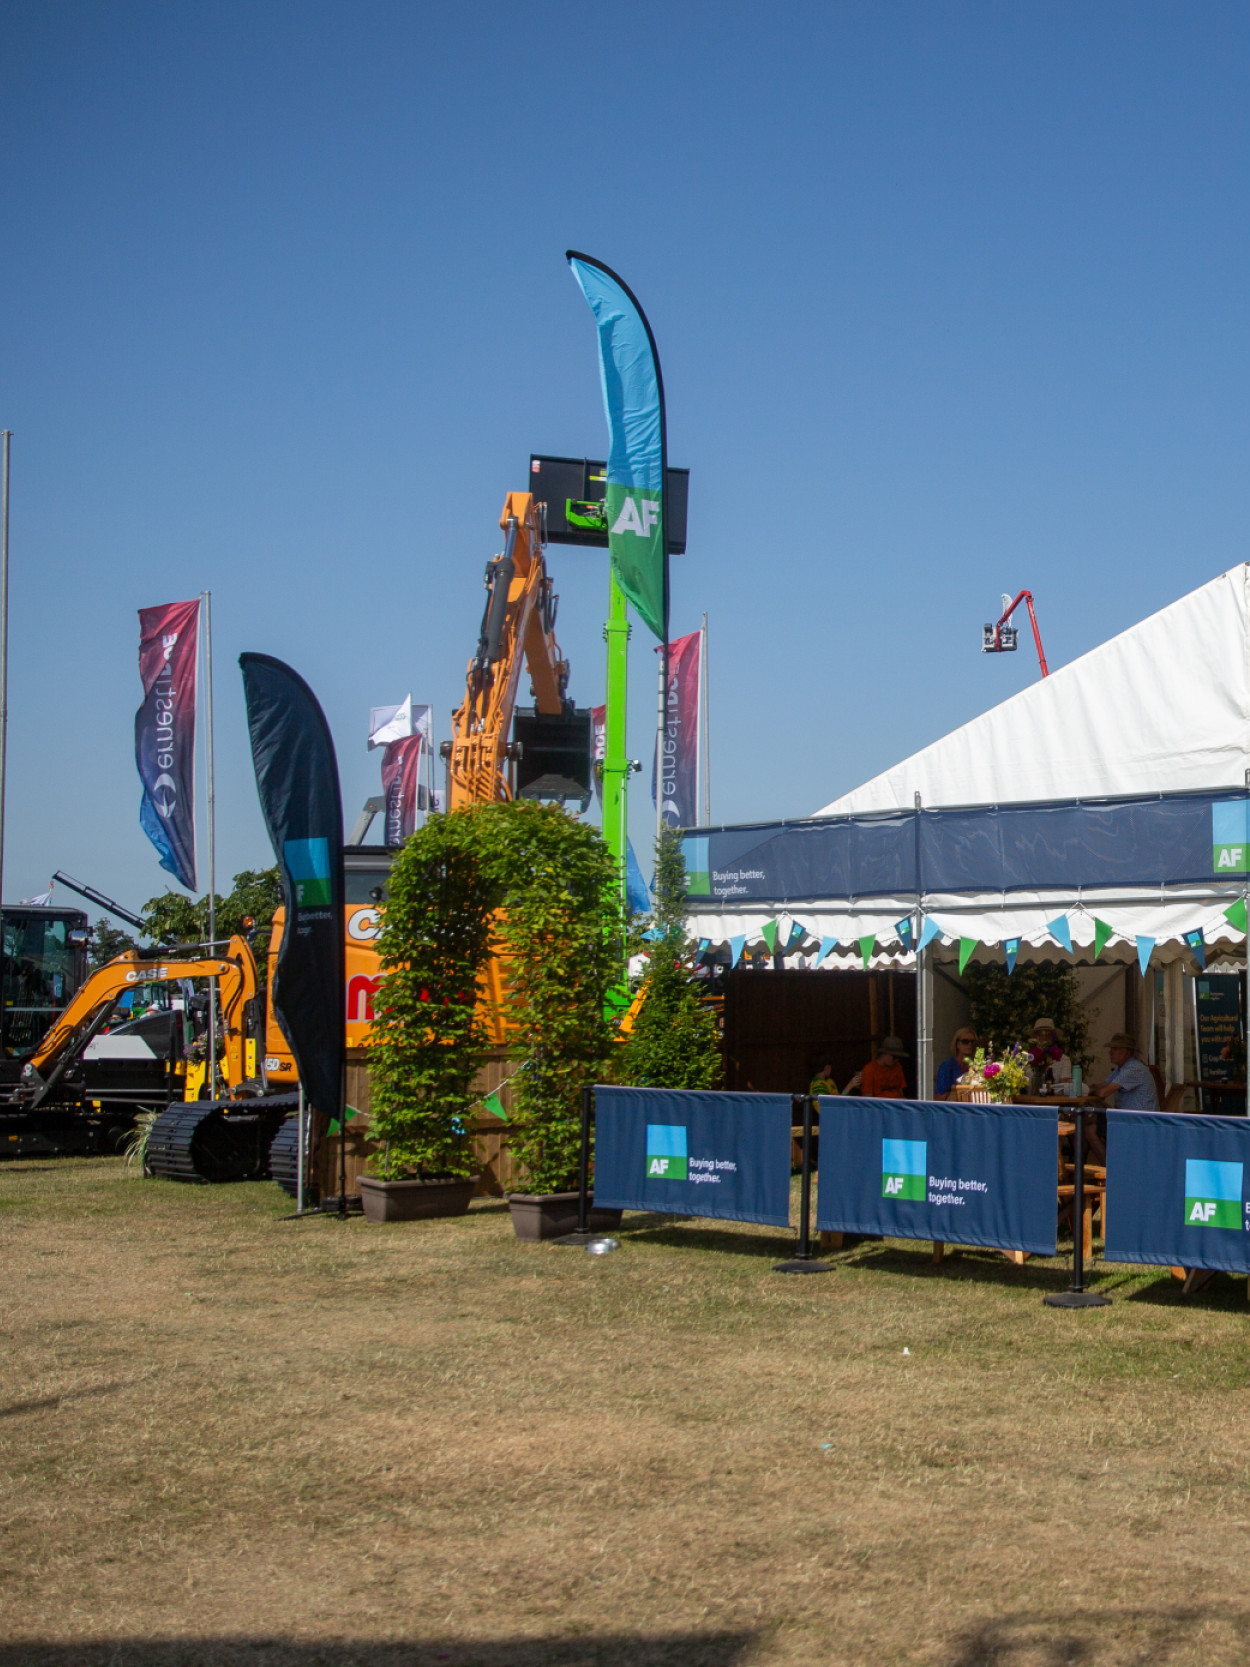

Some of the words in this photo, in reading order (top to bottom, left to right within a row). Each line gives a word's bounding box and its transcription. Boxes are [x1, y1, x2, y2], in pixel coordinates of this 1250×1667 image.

[611, 496, 660, 538] AF
[1218, 848, 1242, 868] AF
[712, 871, 739, 883] Buying
[739, 869, 766, 880] better,
[714, 884, 749, 897] together.
[126, 967, 168, 981] CASE
[649, 1158, 669, 1174] AF
[689, 1157, 715, 1171] Buying
[715, 1159, 738, 1172] better,
[689, 1171, 721, 1184] together.
[885, 1176, 904, 1194] AF
[929, 1175, 957, 1191] Buying
[958, 1178, 988, 1193] better,
[928, 1192, 965, 1206] together.
[1189, 1201, 1217, 1222] AF
